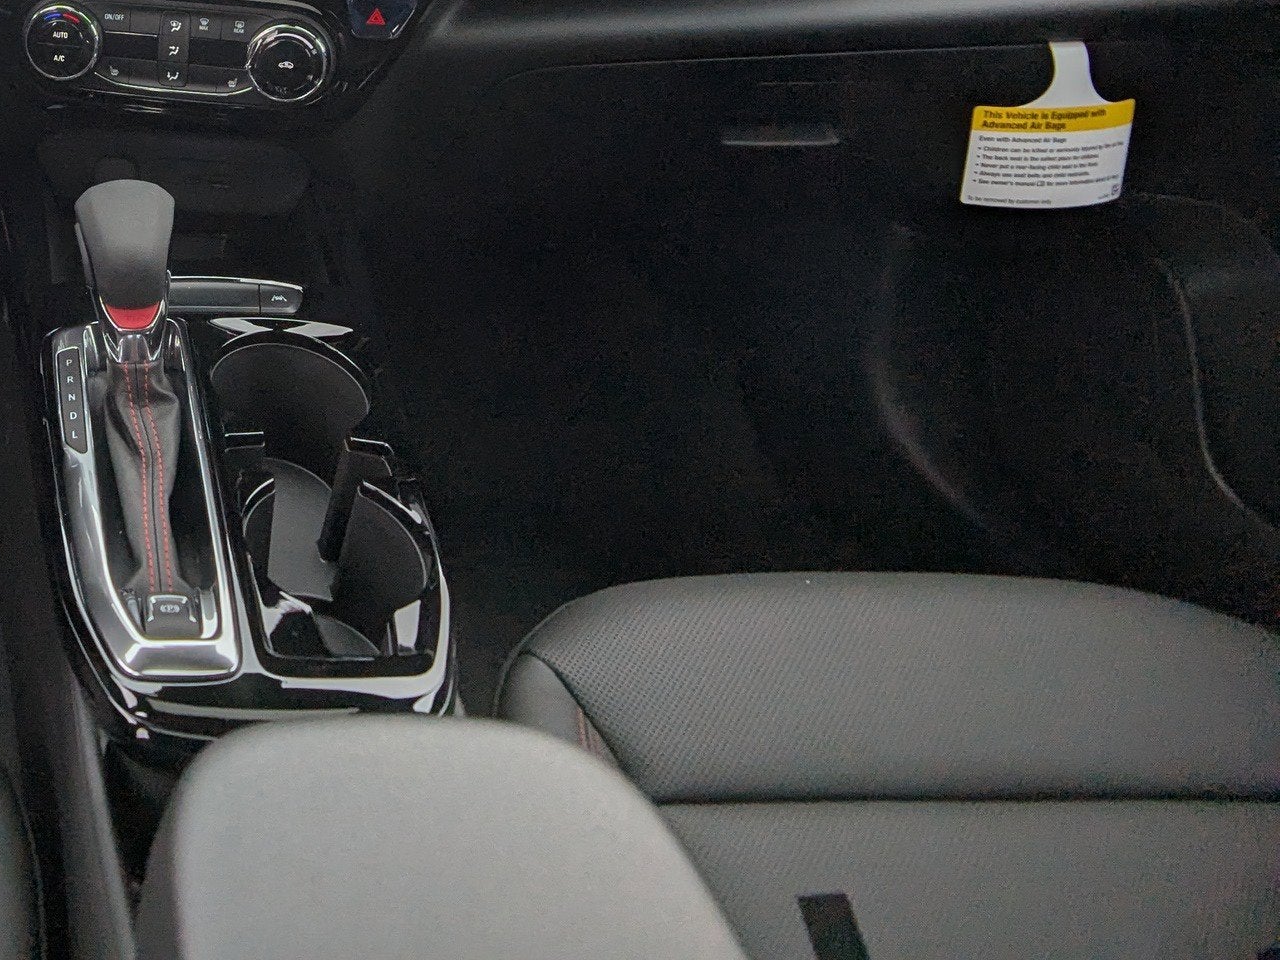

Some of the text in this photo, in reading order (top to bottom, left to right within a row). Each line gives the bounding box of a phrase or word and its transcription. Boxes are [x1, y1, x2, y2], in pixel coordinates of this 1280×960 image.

[104, 13, 125, 21] ON/OFF
[52, 31, 69, 39] AUTO
[53, 54, 66, 62] A/C
[983, 110, 1003, 119] This
[66, 359, 73, 367] P
[67, 375, 74, 384] R
[68, 393, 76, 401] N
[70, 411, 78, 420] D
[71, 430, 78, 439] L
